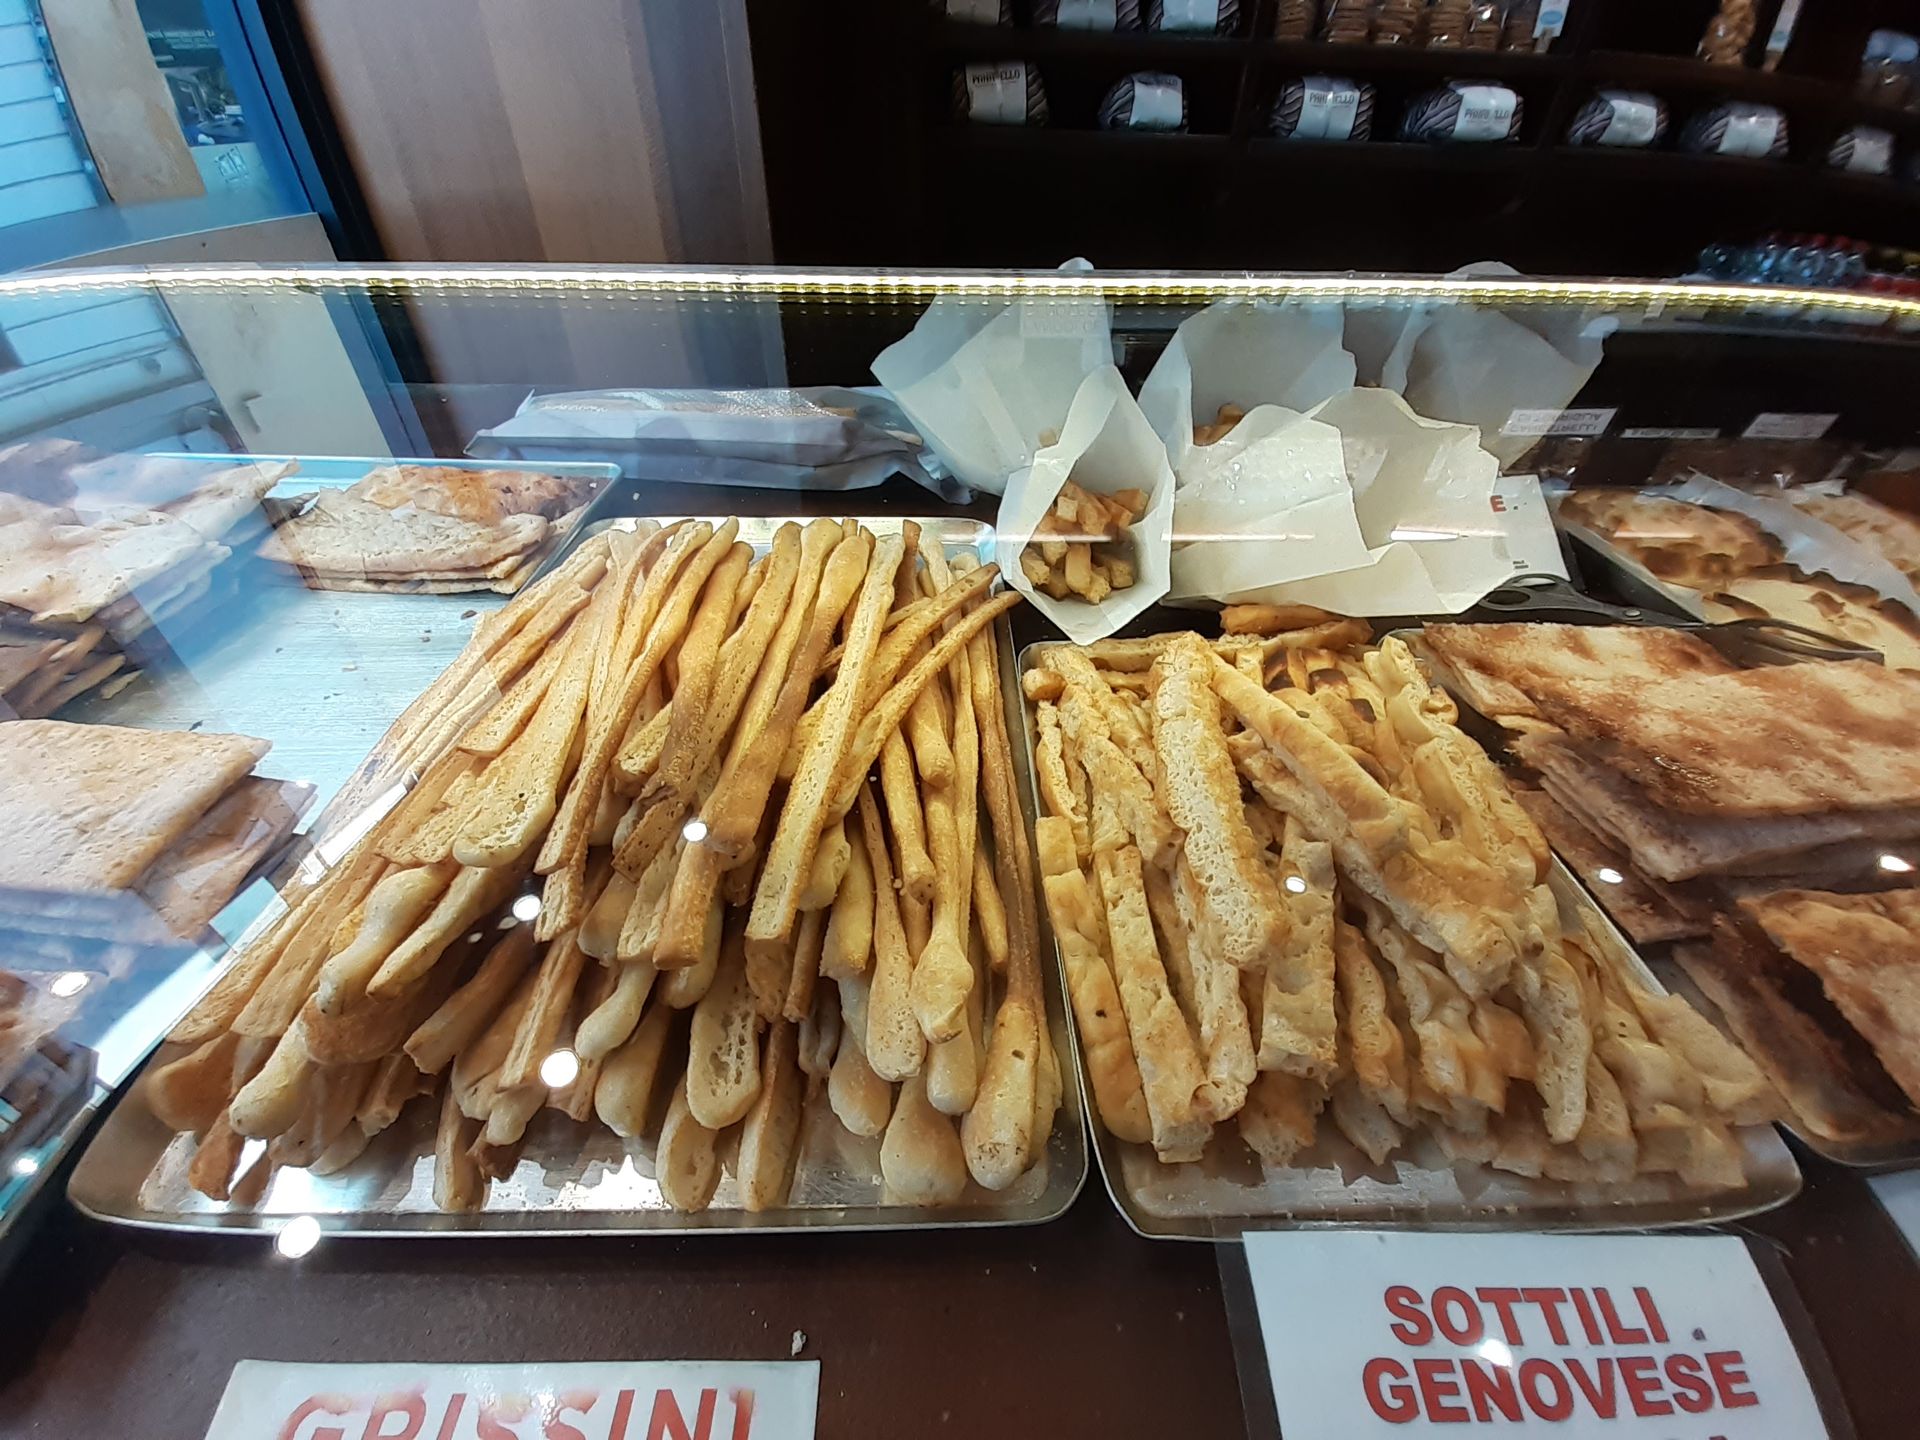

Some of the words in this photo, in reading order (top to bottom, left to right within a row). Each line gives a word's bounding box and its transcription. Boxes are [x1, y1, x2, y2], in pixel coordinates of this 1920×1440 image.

[972, 69, 1021, 84] PANAELLO
[1309, 92, 1355, 105] PANAELLO
[1384, 1285, 1669, 1346] SOTTILI
[1362, 1350, 1759, 1423] GENOVESE
[276, 1388, 756, 1440] GRISSINI
